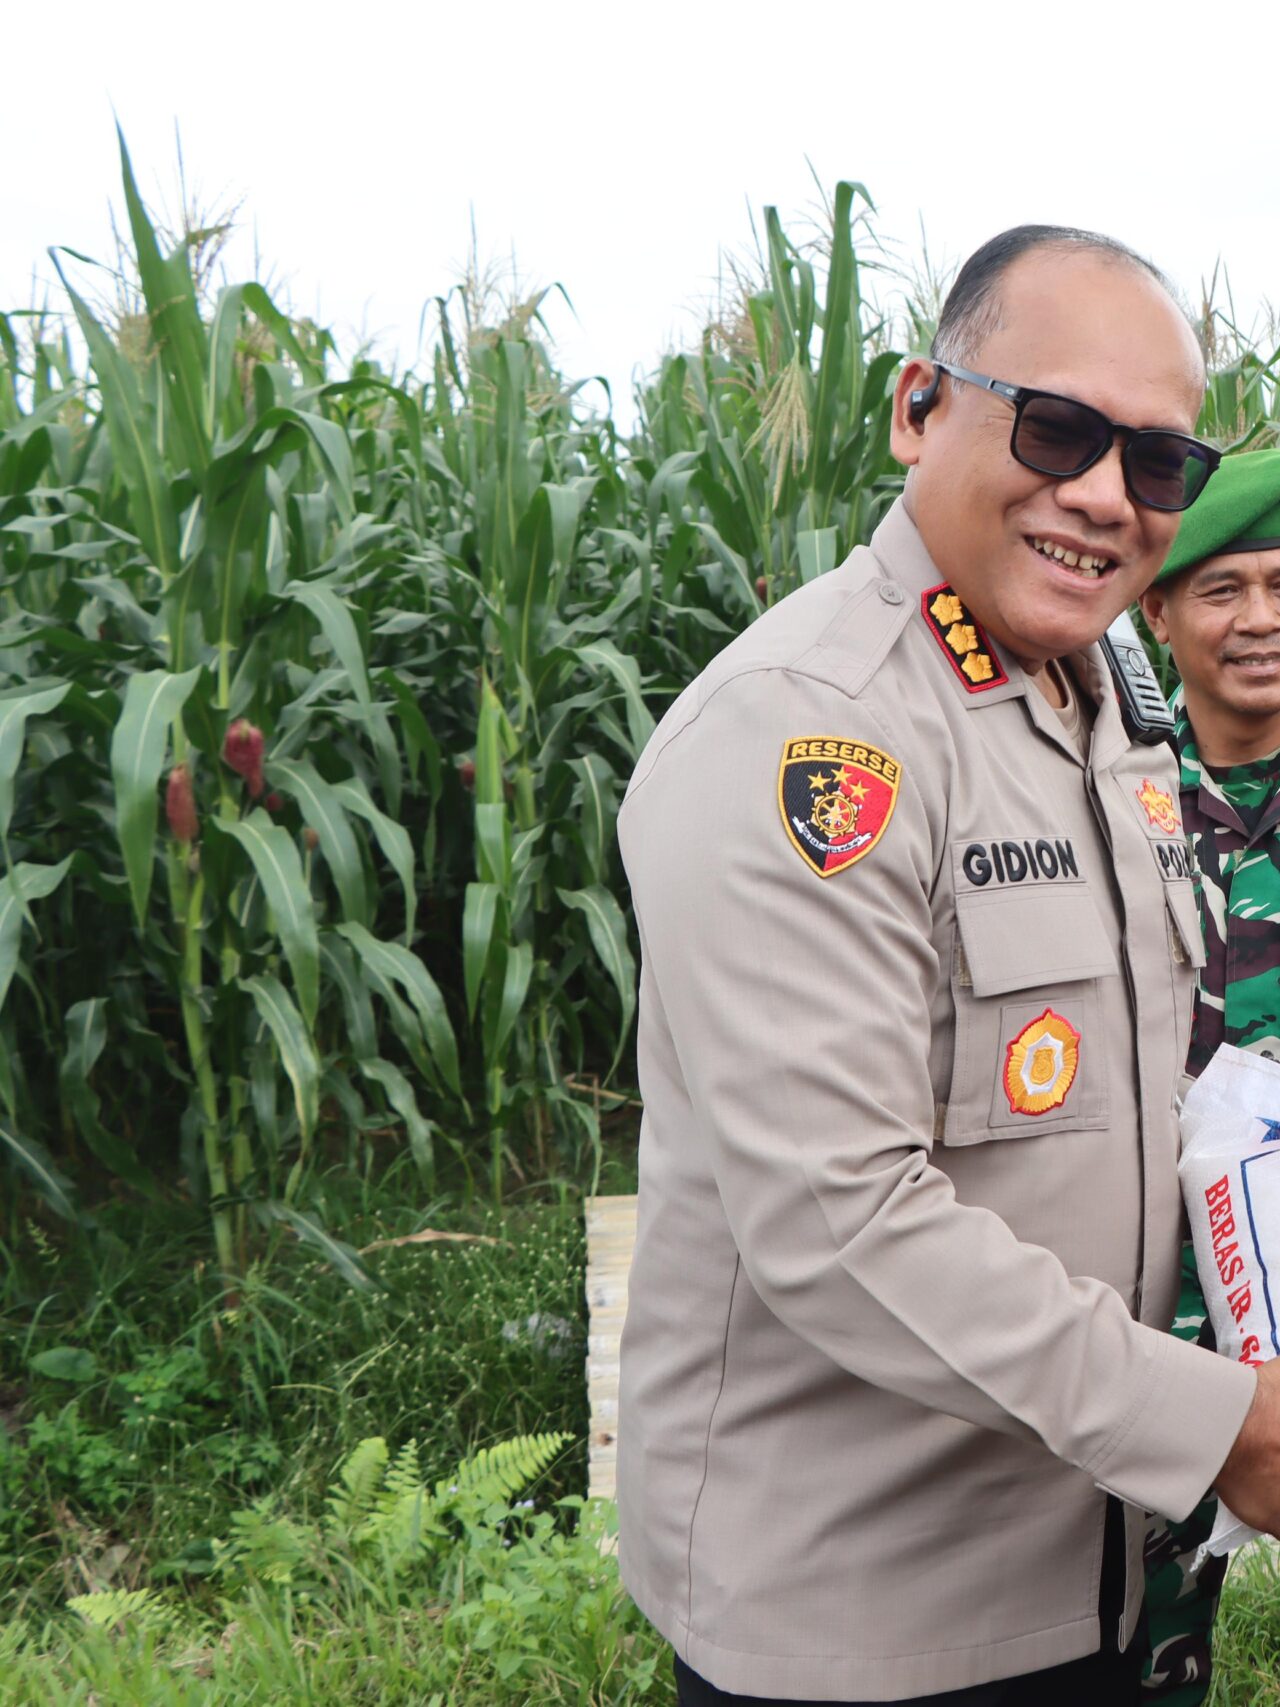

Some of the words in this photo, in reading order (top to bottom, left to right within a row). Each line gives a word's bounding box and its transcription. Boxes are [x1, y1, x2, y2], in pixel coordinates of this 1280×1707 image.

[791, 741, 896, 780] RESERSE
[962, 839, 1079, 886] GIDION
[1205, 1174, 1244, 1286] BERAS
